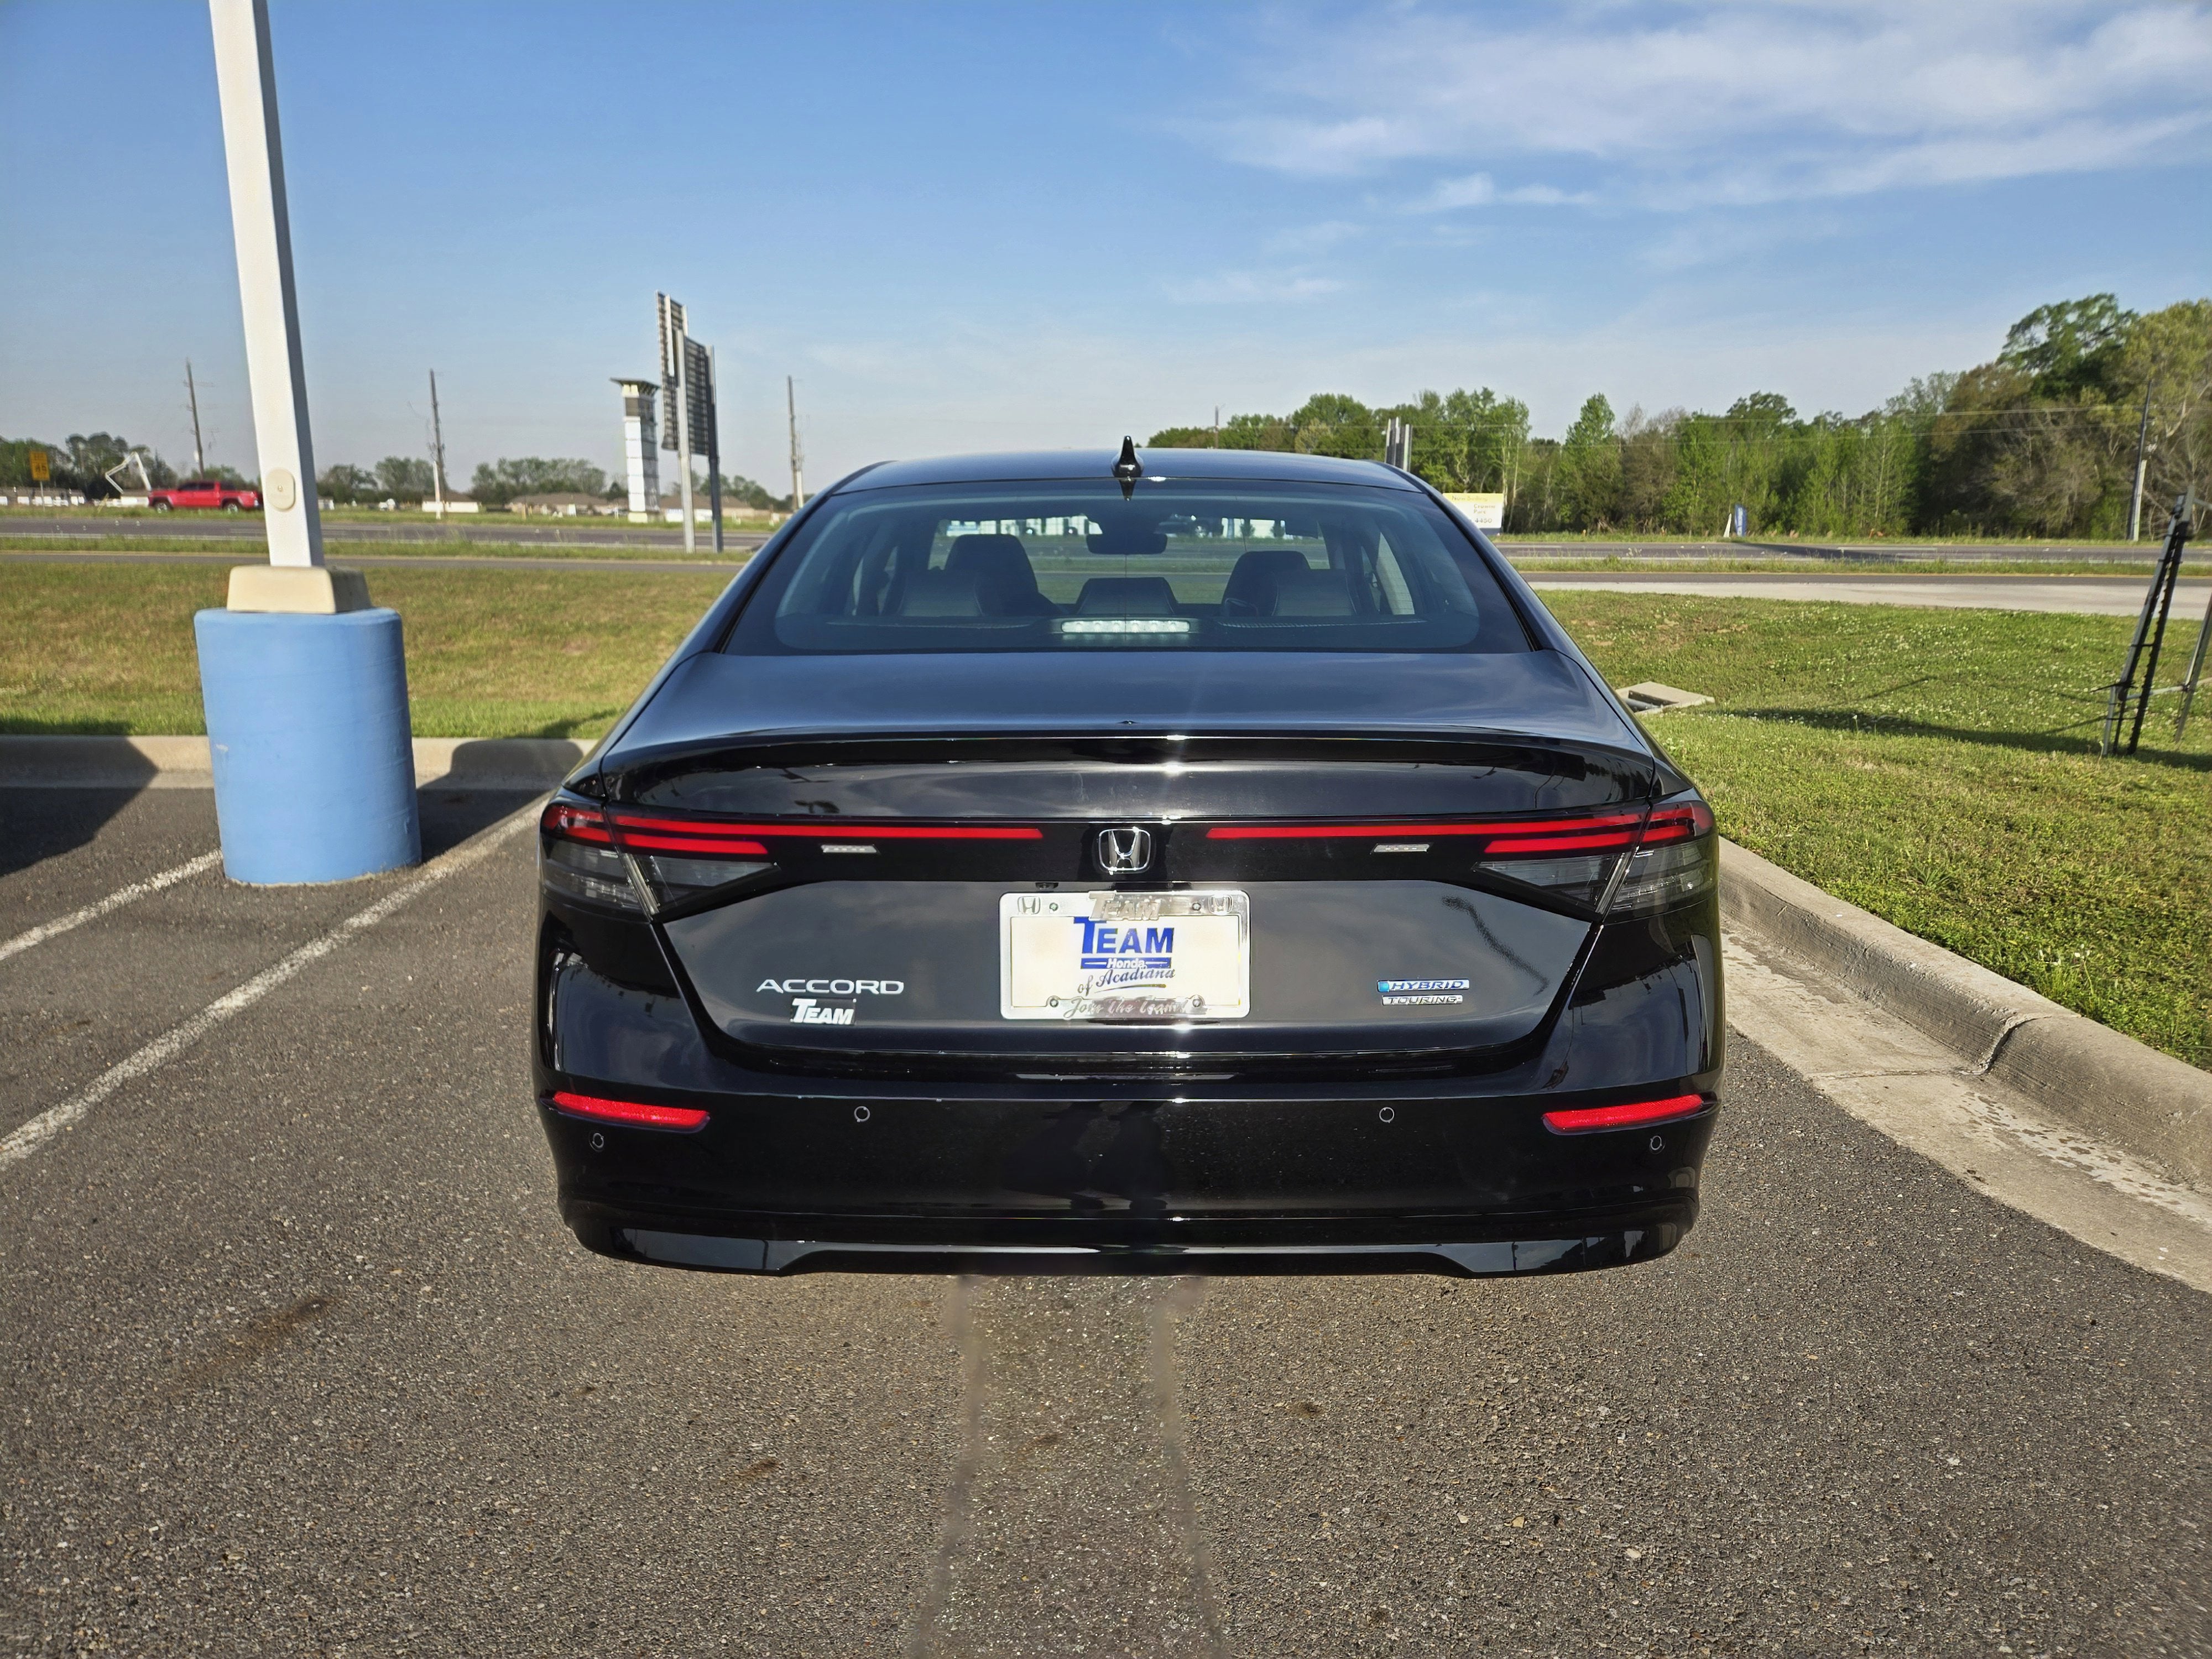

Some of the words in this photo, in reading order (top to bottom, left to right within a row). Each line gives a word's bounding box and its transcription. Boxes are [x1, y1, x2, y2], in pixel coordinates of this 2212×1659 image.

[1074, 916, 1175, 954] TEAM
[1107, 958, 1146, 969] Honda
[756, 979, 904, 994] ACCORD
[1077, 975, 1094, 997] of
[1095, 966, 1176, 988] Acadiana
[1391, 980, 1464, 990] HYBRID
[1387, 996, 1457, 1005] TOURING
[791, 998, 855, 1025] TEAM
